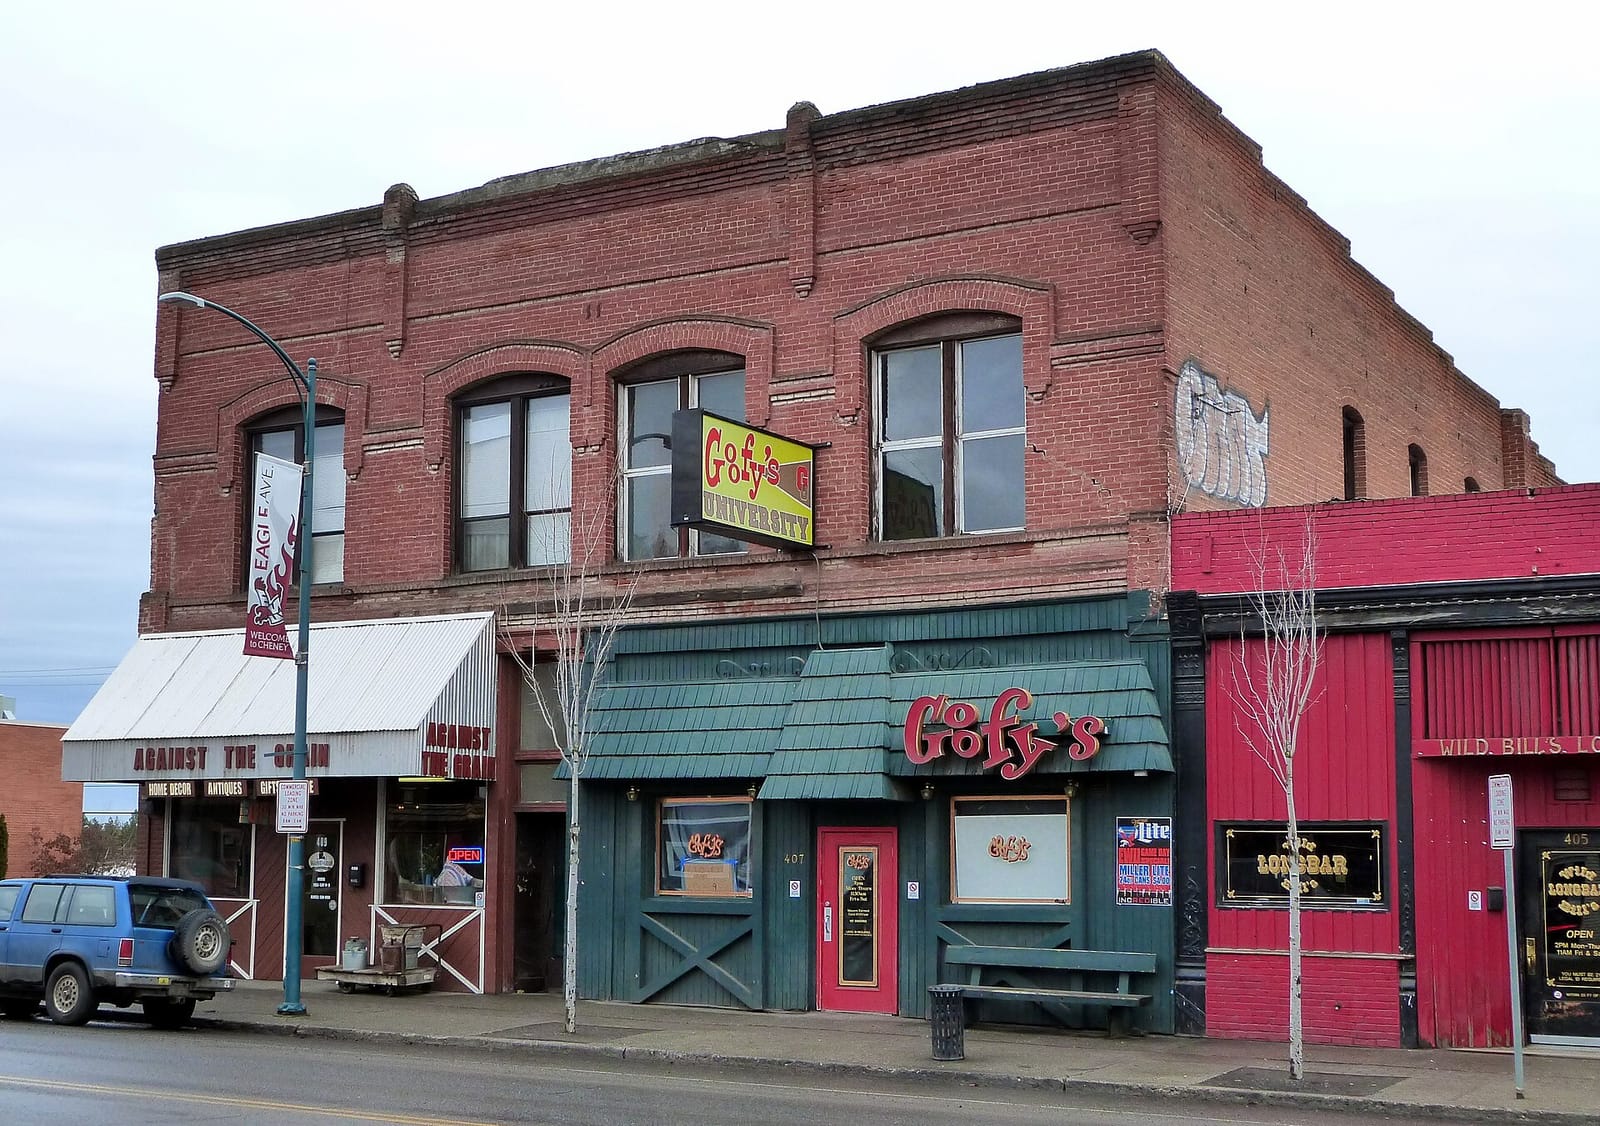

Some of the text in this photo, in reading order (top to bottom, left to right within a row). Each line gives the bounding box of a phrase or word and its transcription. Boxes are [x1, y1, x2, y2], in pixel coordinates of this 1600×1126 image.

[260, 465, 274, 504] AVE.
[703, 490, 809, 541] UNIVERSITY
[250, 631, 289, 643] WELCOME
[250, 640, 289, 651] to CHENEY
[427, 722, 491, 751] AGAINST
[1439, 738, 1489, 756] WILD
[1502, 737, 1562, 755] BILL'S
[133, 746, 207, 771] AGAINST
[224, 744, 256, 769] THE
[422, 751, 497, 780] THE GRAIN
[148, 782, 192, 796] HOME DECOR
[207, 781, 242, 796] ANTIQUES
[1135, 822, 1169, 843] Lite
[1564, 833, 1589, 845] 405
[448, 850, 480, 861] OPEN
[784, 854, 805, 865] 407
[1119, 865, 1169, 876] MILLER LITE
[1134, 876, 1150, 884] CANS
[1566, 929, 1594, 939] OPEN
